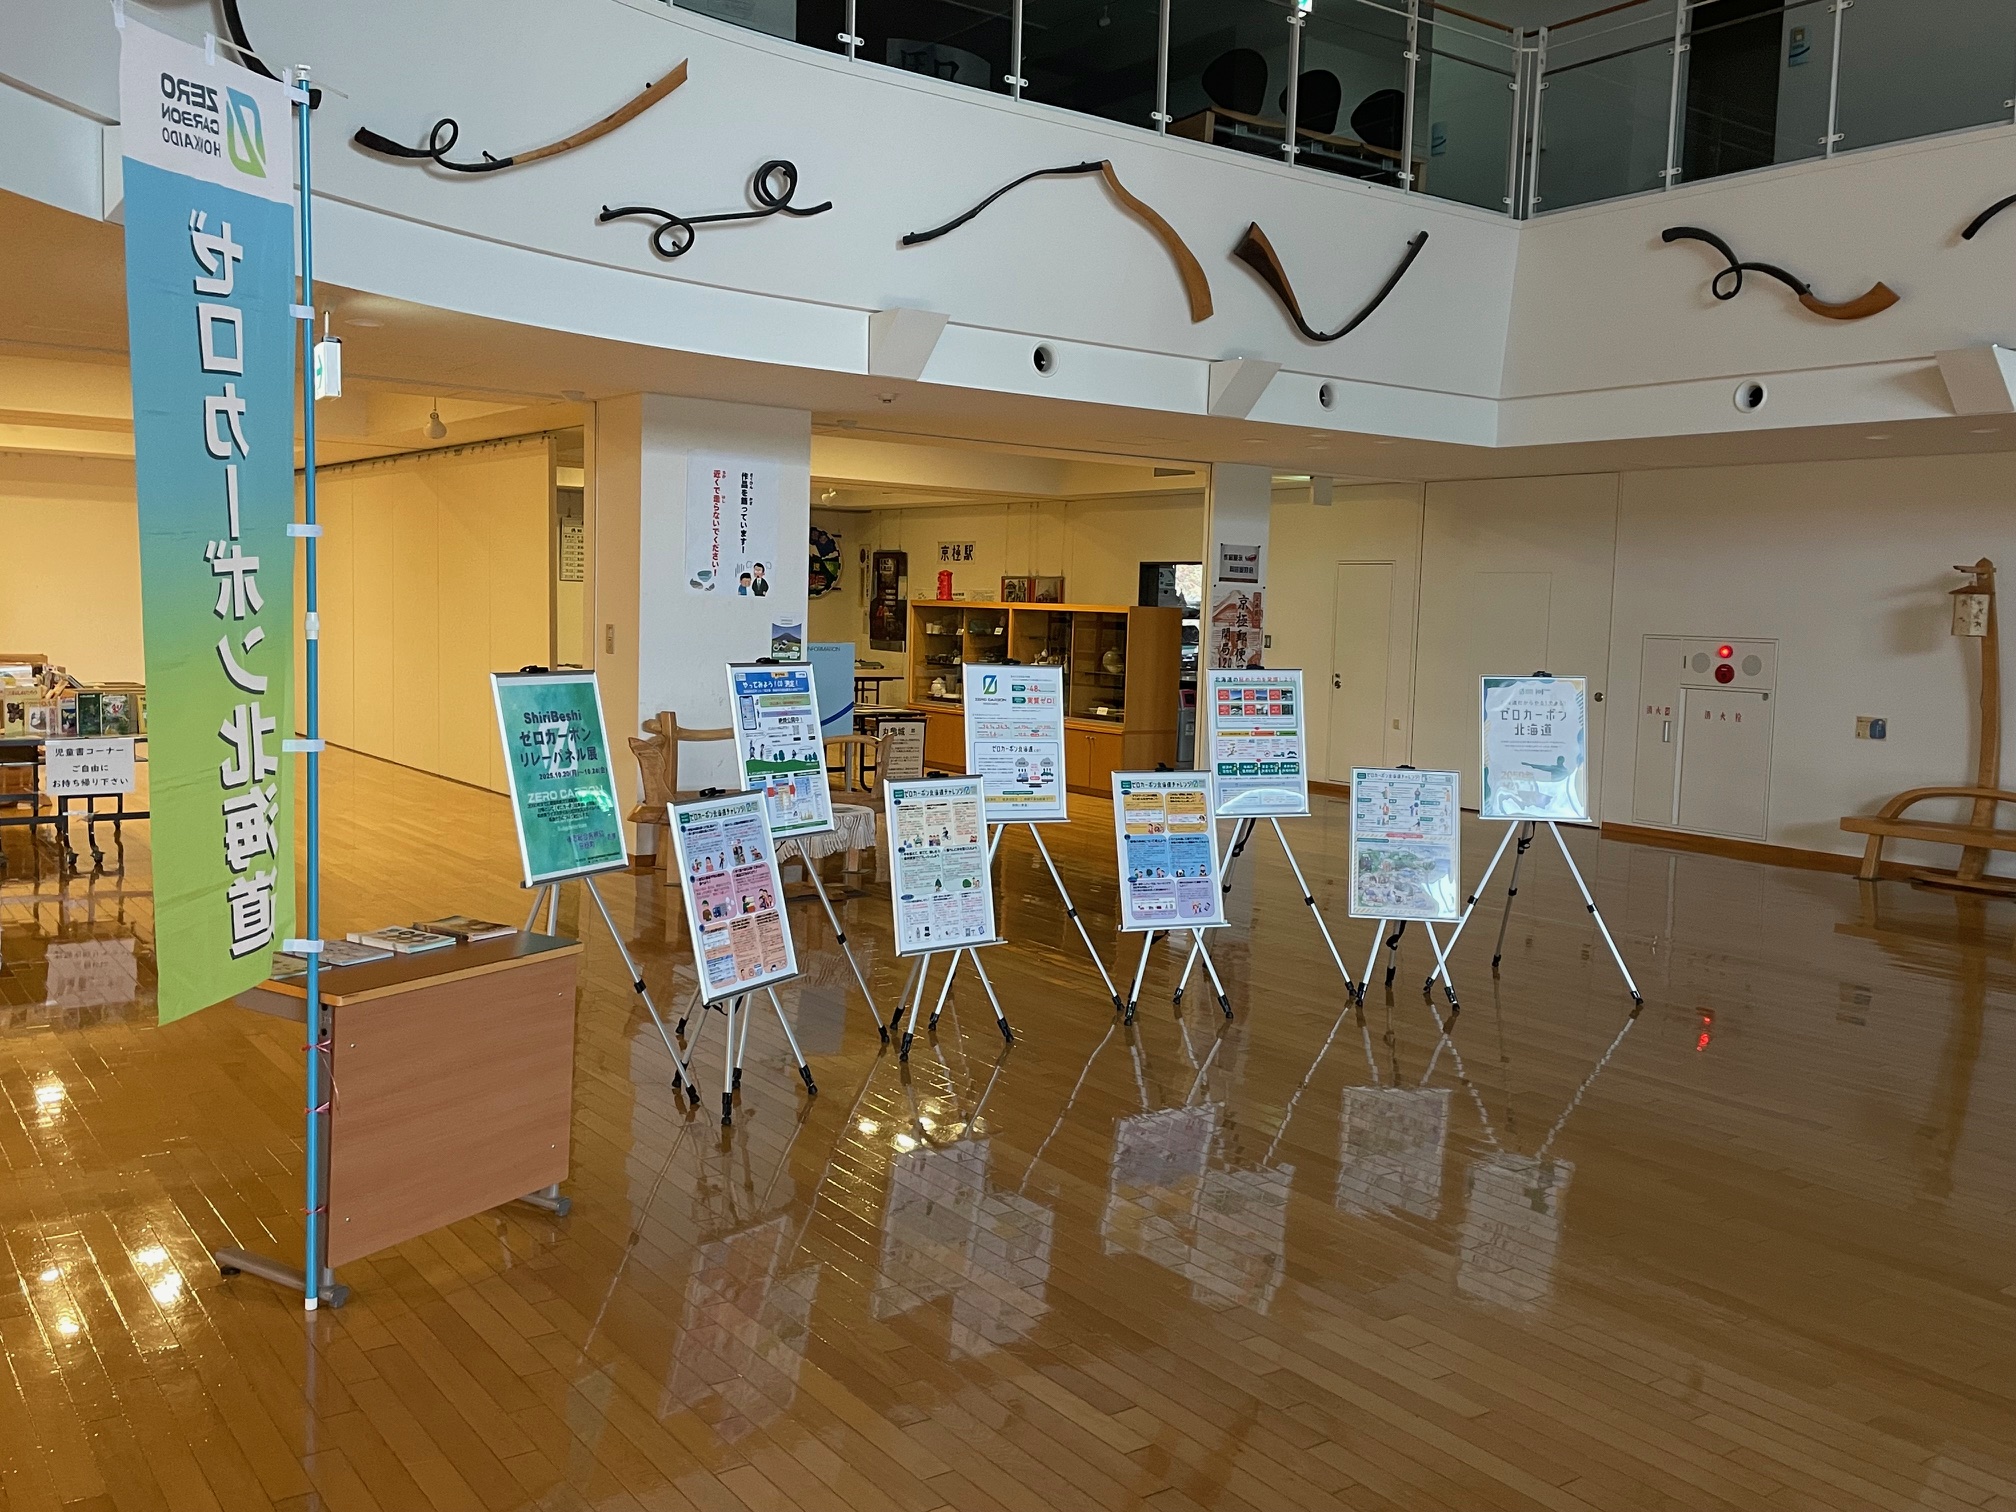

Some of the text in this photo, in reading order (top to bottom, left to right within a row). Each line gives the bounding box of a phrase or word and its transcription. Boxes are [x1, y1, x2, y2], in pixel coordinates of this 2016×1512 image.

[940, 544, 974, 562] 京極駅
[523, 709, 582, 725] ShiriBeshi
[1500, 707, 1567, 722] ゼロカーボン
[1646, 705, 1671, 716] 消火器
[1704, 710, 1742, 722] 消火栓
[519, 726, 592, 747] ゼロカーボン
[1514, 722, 1552, 737] 北海道
[55, 747, 125, 757] 児童書コーナー
[520, 746, 599, 768] リレーパネル展
[72, 764, 109, 773] ご自由に
[52, 777, 129, 788] お持ち帰り下さい
[527, 789, 558, 804] ZERO
